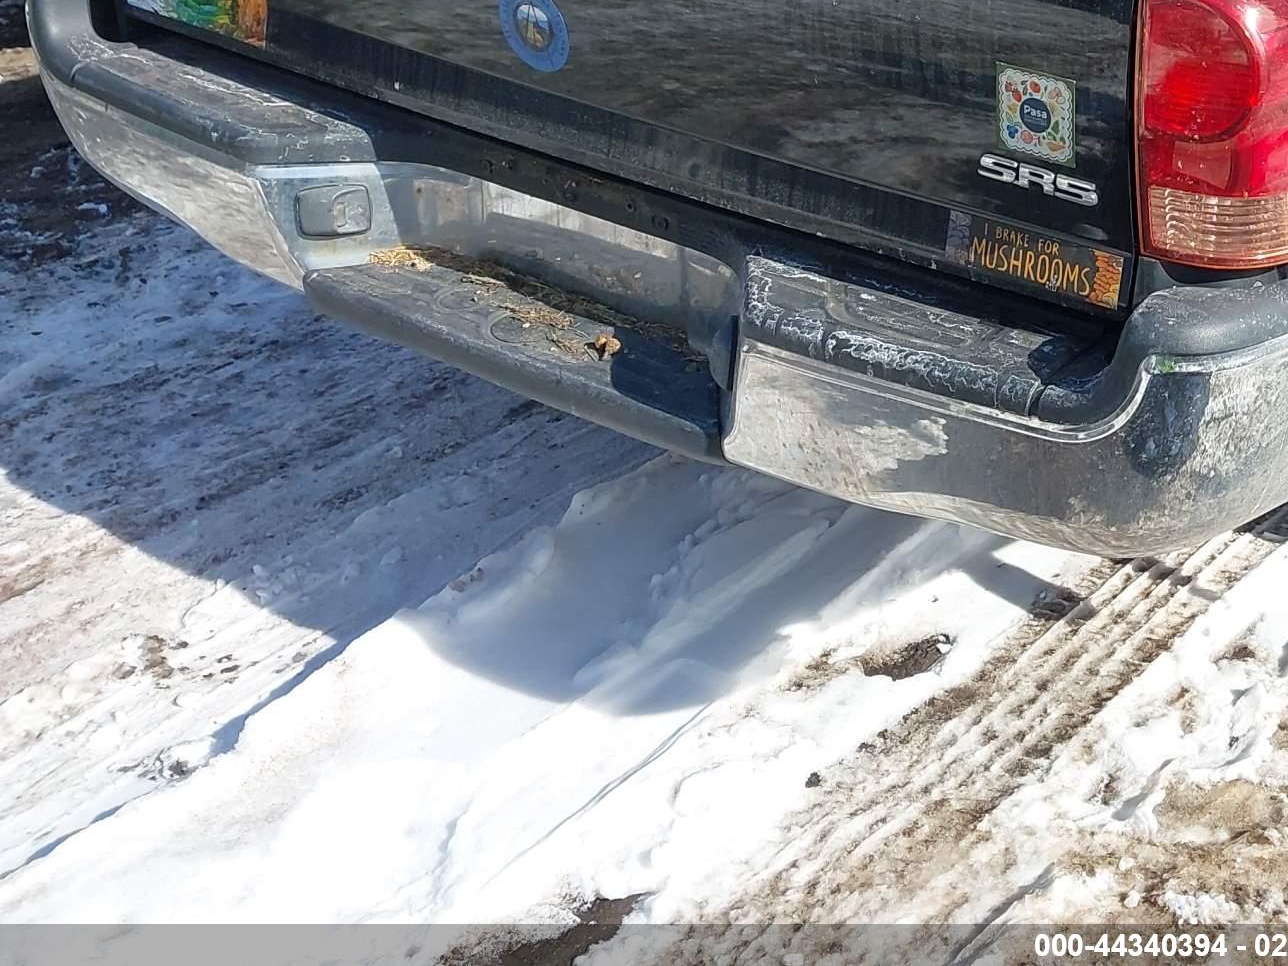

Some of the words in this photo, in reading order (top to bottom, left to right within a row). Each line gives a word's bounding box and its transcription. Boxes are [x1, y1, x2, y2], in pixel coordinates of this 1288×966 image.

[1023, 104, 1047, 119] Pasa
[977, 153, 1099, 207] SR5
[984, 222, 989, 235] I
[995, 226, 1031, 249] BRAKE
[1038, 238, 1060, 256] FOR
[970, 237, 1091, 297] MUSHROOMS
